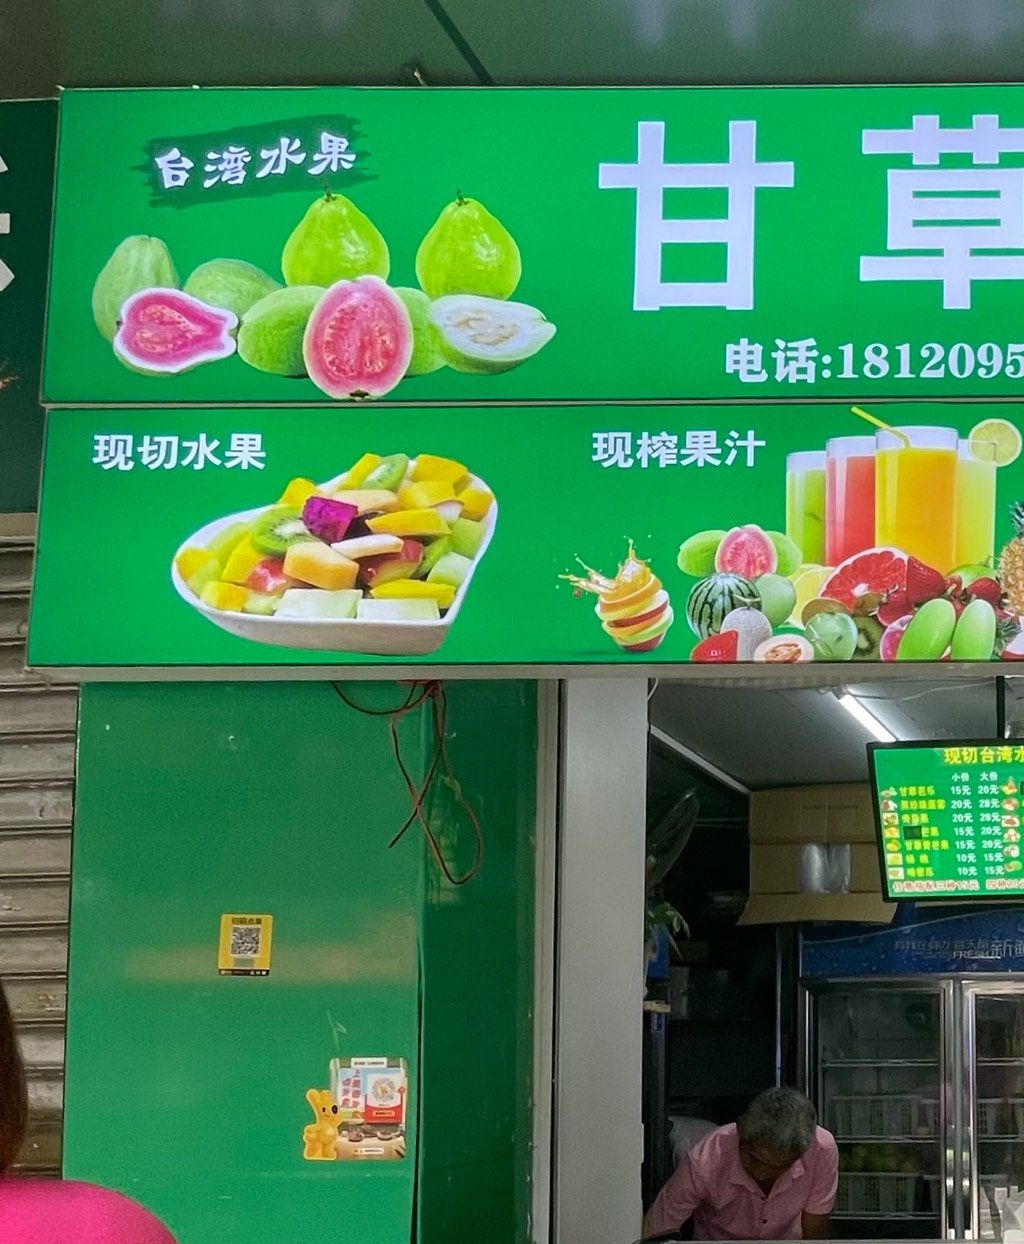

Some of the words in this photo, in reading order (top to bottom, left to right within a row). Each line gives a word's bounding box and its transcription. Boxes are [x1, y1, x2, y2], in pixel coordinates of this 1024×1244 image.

[155, 132, 356, 188] 台湾水果
[93, 433, 266, 470] 现切水果
[592, 430, 765, 468] 现榨果汁
[952, 772, 970, 782] 小份
[980, 771, 998, 781] 大份
[951, 785, 971, 796] 15元
[978, 784, 999, 795] 20元
[951, 799, 972, 810] 20元
[979, 798, 1000, 809] 28元
[953, 812, 973, 823] 20元
[980, 812, 1001, 823] 28元
[954, 826, 974, 837] 15元
[981, 825, 1002, 836] 20元
[955, 839, 975, 850] 15元
[982, 839, 1003, 850] 20元
[957, 853, 976, 863] 10元
[984, 852, 1004, 862] 15元
[957, 866, 977, 876] 10元
[985, 865, 1005, 875] 15元
